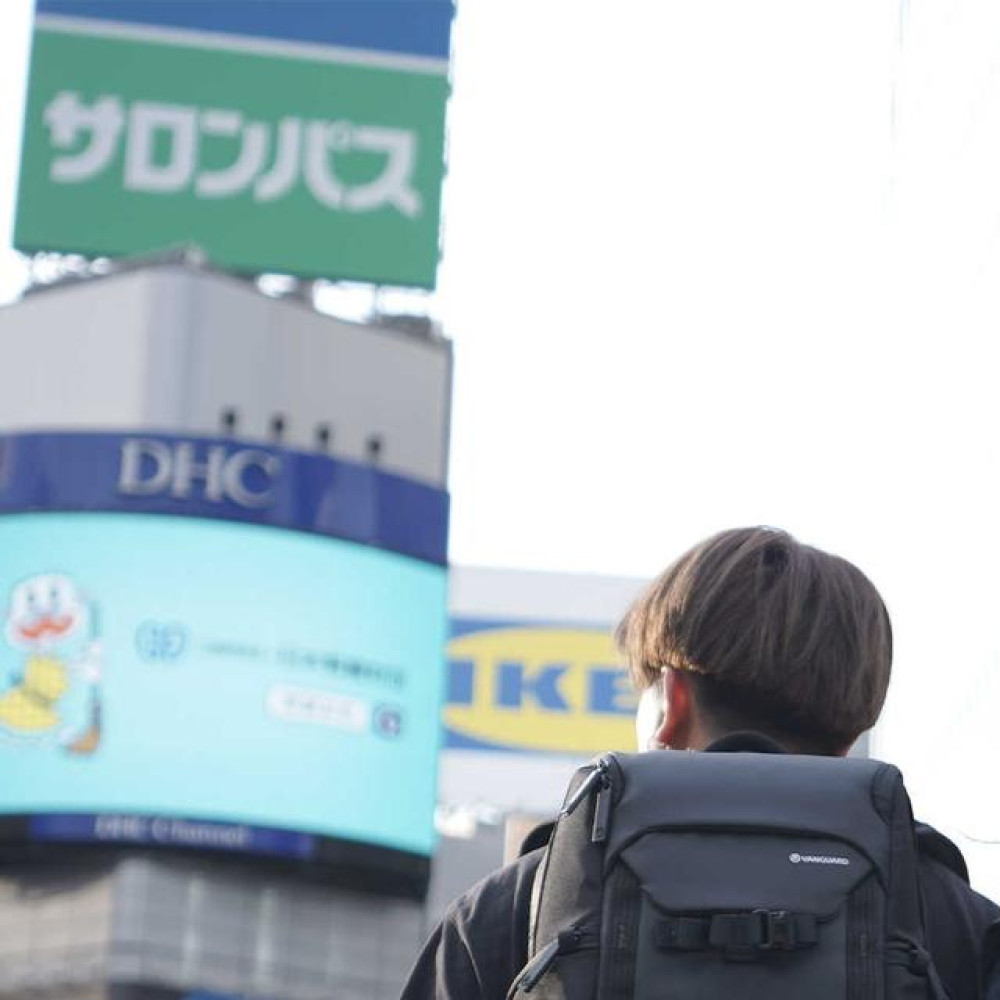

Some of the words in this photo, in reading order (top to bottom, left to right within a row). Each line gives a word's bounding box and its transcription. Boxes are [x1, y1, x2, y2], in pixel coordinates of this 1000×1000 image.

[43, 90, 421, 217] サロンパス
[118, 437, 283, 508] DHC
